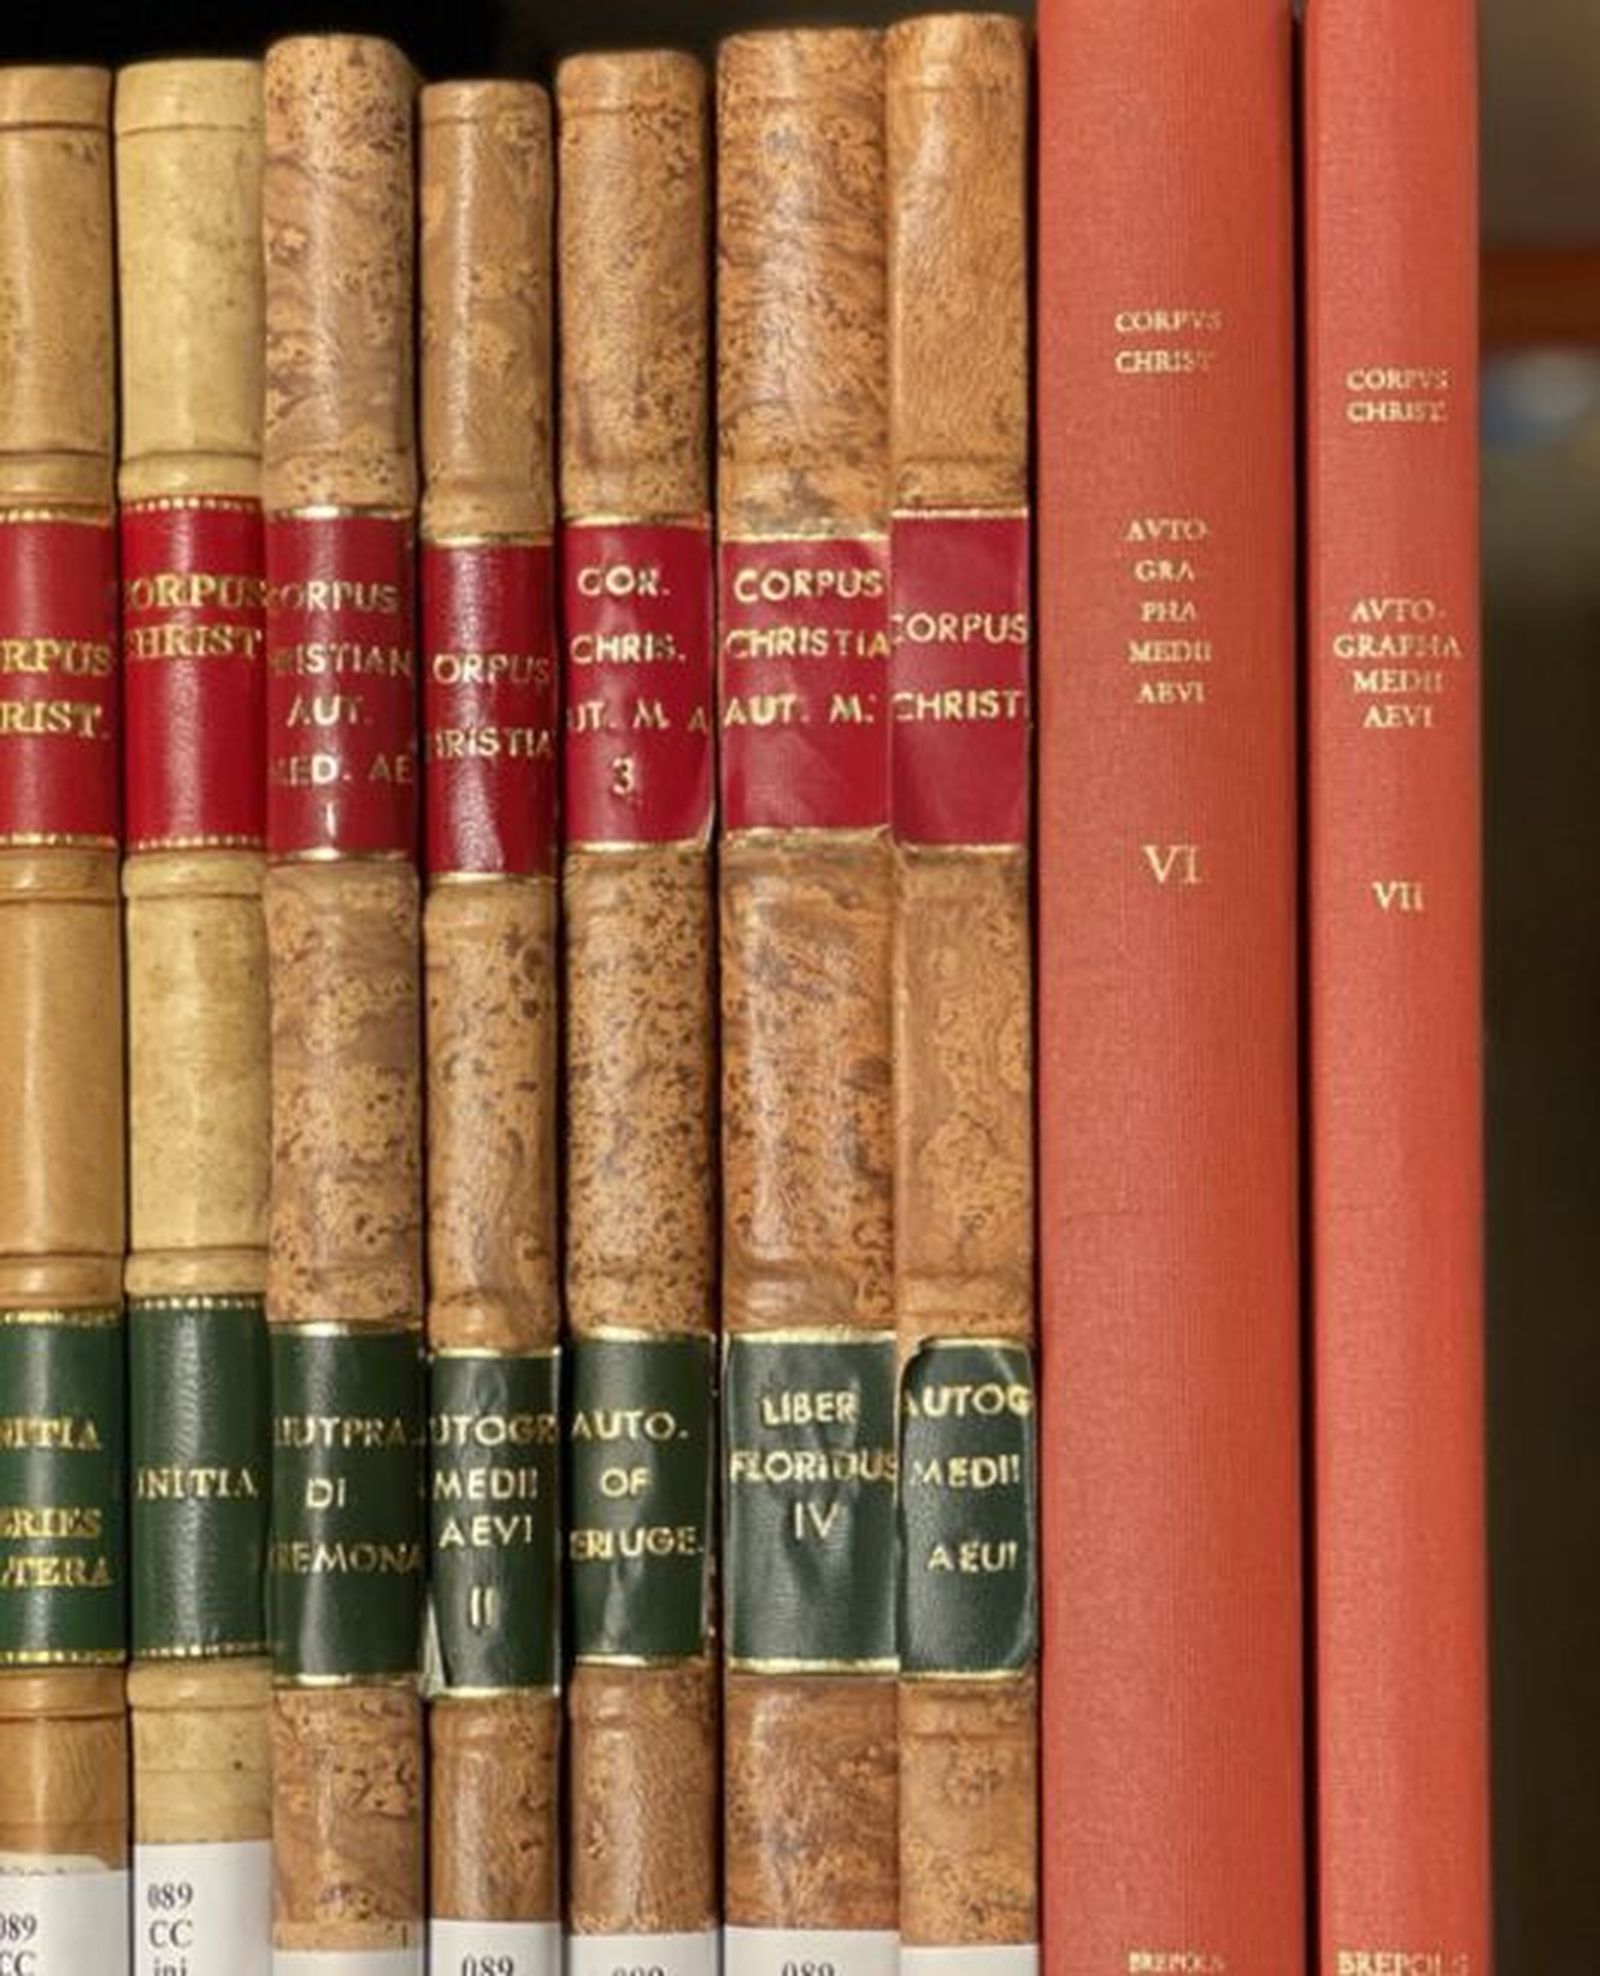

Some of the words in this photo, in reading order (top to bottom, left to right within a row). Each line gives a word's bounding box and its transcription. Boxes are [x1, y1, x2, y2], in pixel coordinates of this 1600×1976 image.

[1115, 310, 1222, 332] CORPVS
[1346, 368, 1450, 391] CORPVS
[124, 574, 269, 612] ORPUS
[267, 580, 398, 614] ORPUS
[577, 564, 672, 598] COR.
[734, 568, 884, 603] CORPUS
[1128, 641, 1212, 663] MEDII
[1333, 634, 1462, 658] GRAPHA
[1138, 681, 1205, 703] AEVI
[1353, 669, 1442, 693] MEDII
[1363, 705, 1434, 728] AEVI
[611, 757, 635, 795] 3
[1144, 845, 1201, 884] VI
[1373, 881, 1425, 911] VII
[571, 1409, 689, 1441] AUTO.
[761, 1391, 857, 1426] LIBER
[138, 1465, 258, 1499] INITIA
[434, 1467, 538, 1501] MEDII
[600, 1465, 652, 1498] OF
[909, 1454, 1020, 1489] MEDII
[306, 1477, 346, 1509] DI
[439, 1515, 533, 1549] AEVI
[795, 1501, 840, 1540] IV
[148, 1883, 194, 1910] 089
[149, 1919, 193, 1948] CC
